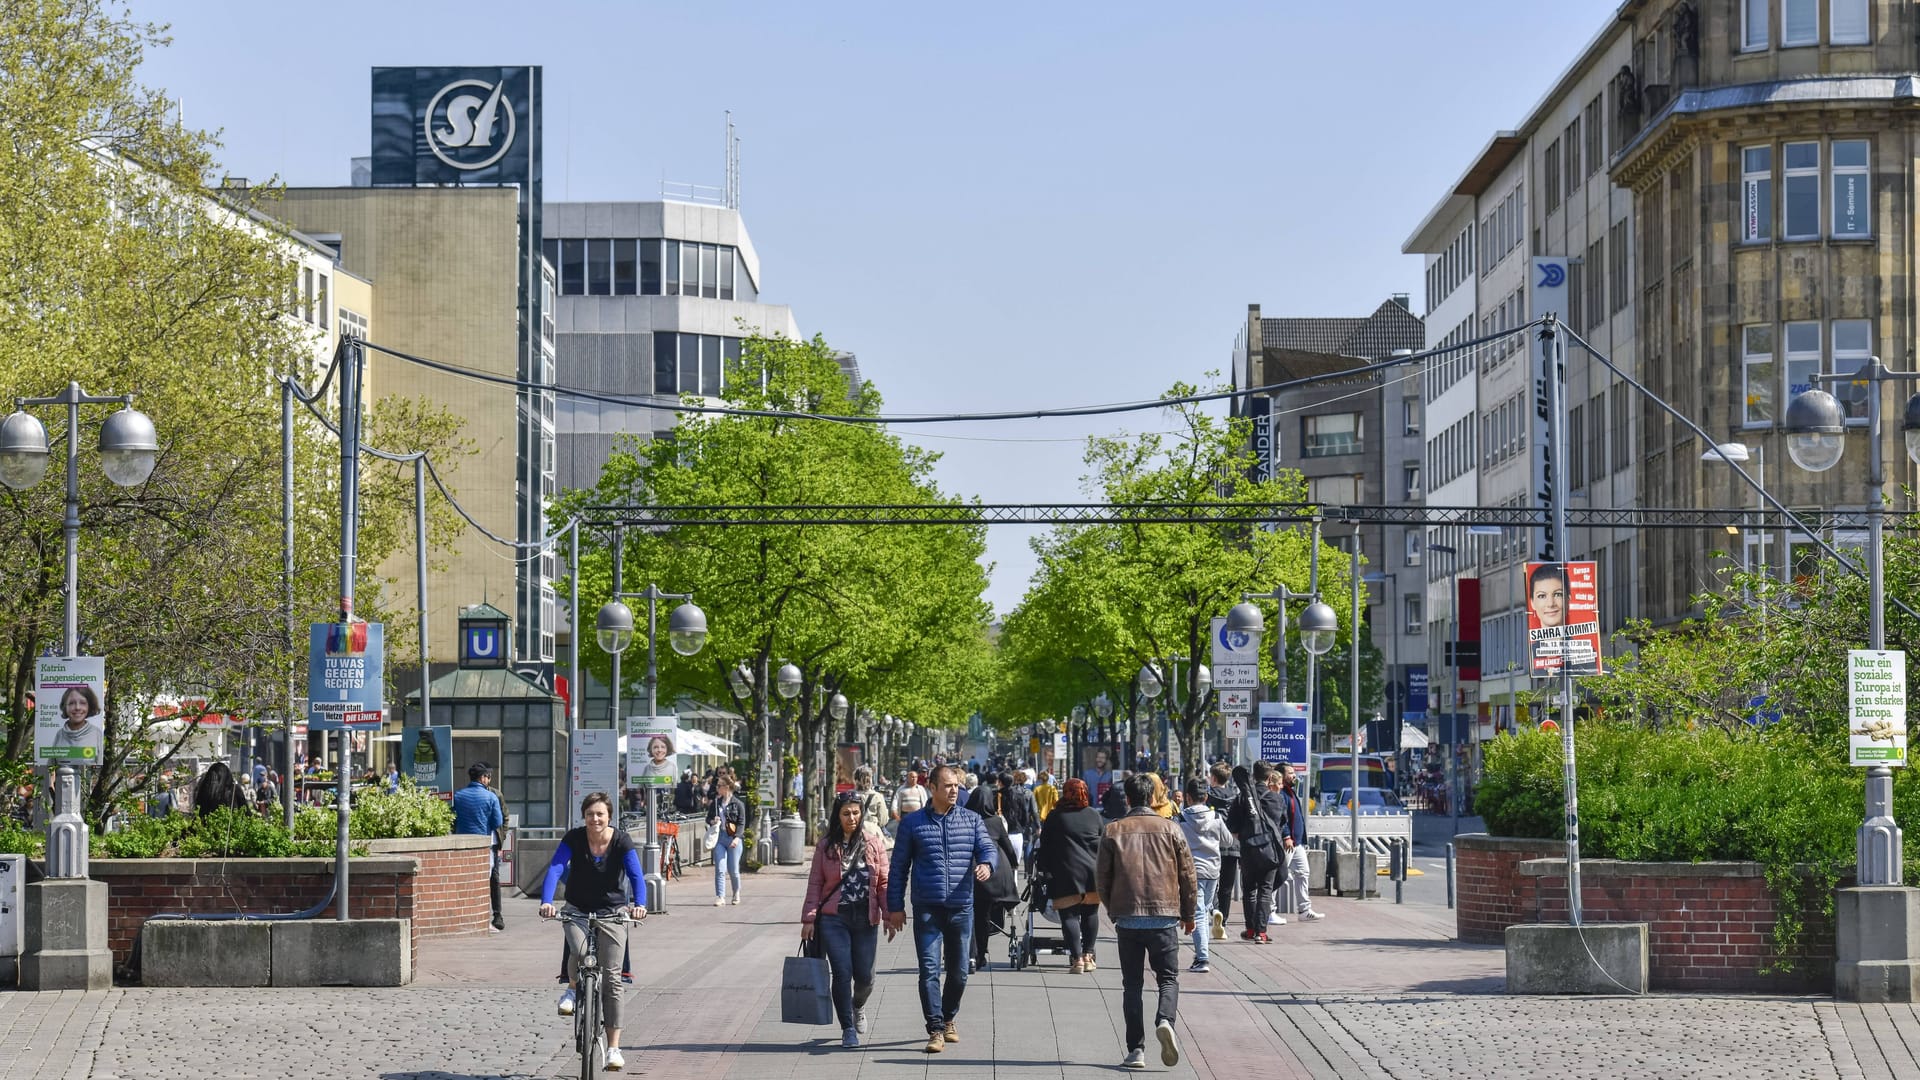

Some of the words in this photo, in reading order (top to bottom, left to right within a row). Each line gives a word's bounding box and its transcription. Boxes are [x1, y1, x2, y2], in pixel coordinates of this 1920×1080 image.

[1847, 178, 1856, 216] Seminare
[1847, 222, 1855, 230] IT
[1531, 628, 1560, 640] SAHRA
[1564, 622, 1596, 636] KOMMT!
[473, 630, 493, 656] U
[325, 659, 337, 668] TU
[340, 659, 364, 668] WAS
[1854, 657, 1875, 667] Nur
[1878, 657, 1892, 667] ein
[40, 674, 97, 683] Langensiepen
[325, 669, 364, 678] GEGEN
[1854, 669, 1893, 679] soziales
[1855, 682, 1890, 694] Europa
[1892, 682, 1901, 692] ist
[1855, 695, 1872, 705] ein
[1875, 695, 1904, 705] starkes
[313, 703, 345, 712] Solidarität
[346, 704, 362, 712] statt
[326, 712, 343, 720] Hetze
[345, 714, 357, 722] DIE
[1856, 707, 1893, 720] Europa.
